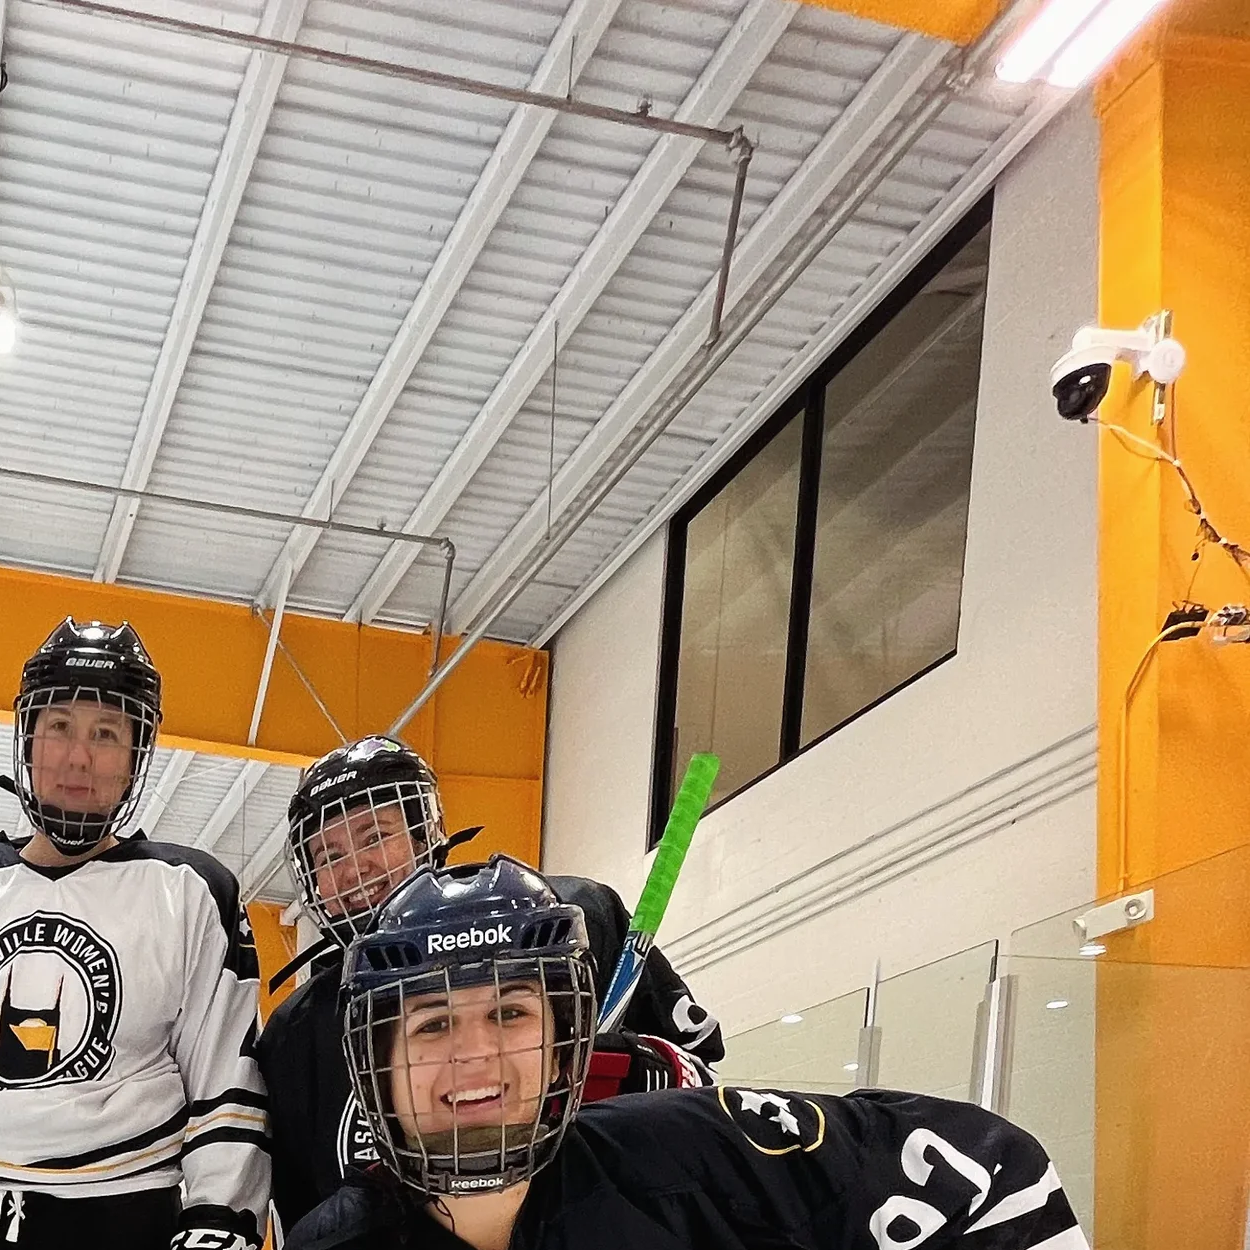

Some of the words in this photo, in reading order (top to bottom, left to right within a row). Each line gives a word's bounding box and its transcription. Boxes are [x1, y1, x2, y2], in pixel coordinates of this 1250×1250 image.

[65, 657, 115, 669] BAUER
[310, 770, 358, 797] BAUER
[427, 923, 512, 954] Reebok
[53, 923, 110, 1014] WOMEN'S
[451, 1176, 504, 1189] Reebok
